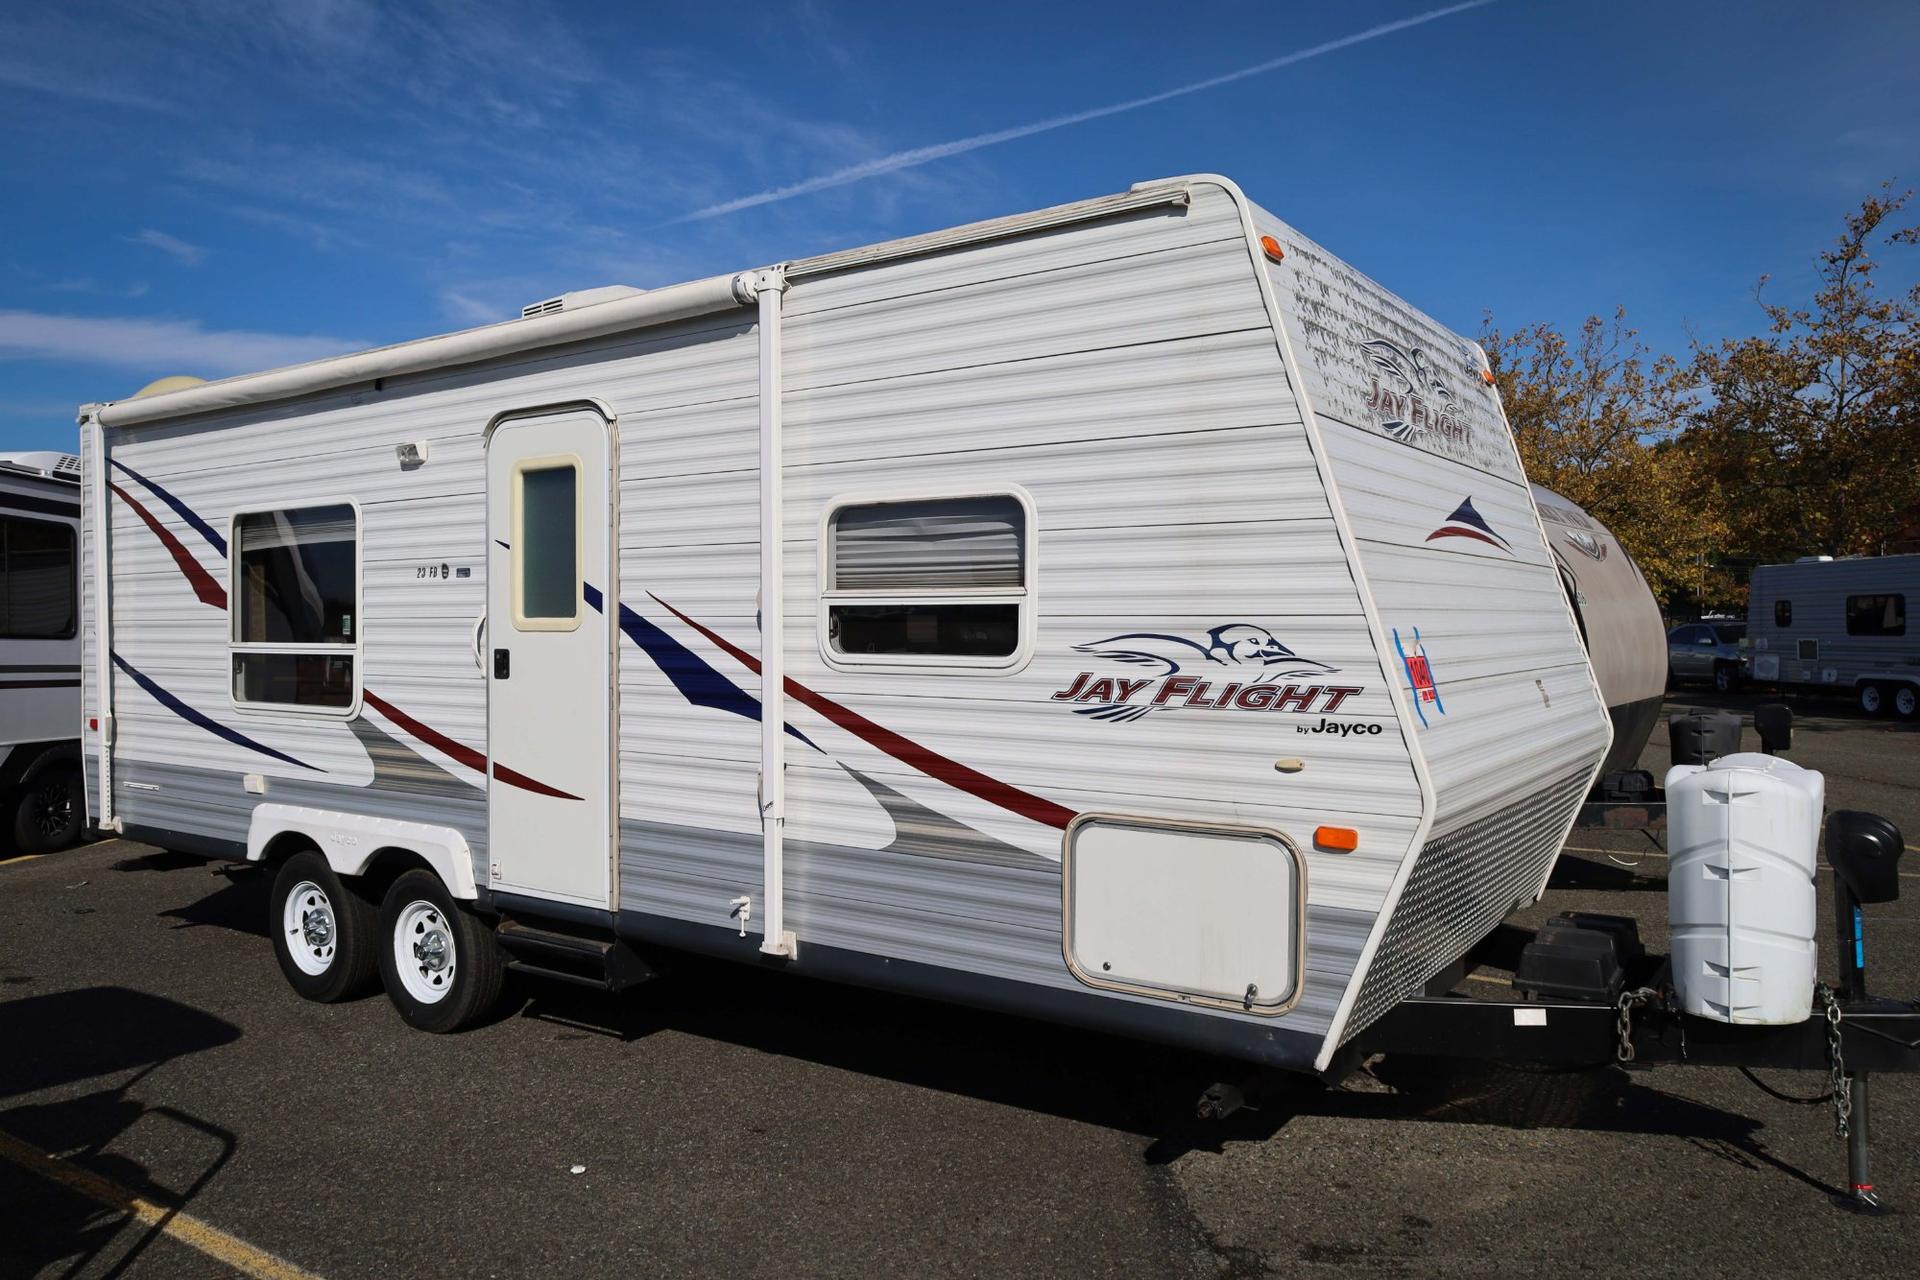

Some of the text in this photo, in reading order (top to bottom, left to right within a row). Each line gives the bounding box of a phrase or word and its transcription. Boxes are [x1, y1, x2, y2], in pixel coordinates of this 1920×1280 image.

[1366, 377, 1473, 446] JAY FLIGHT
[416, 567, 426, 579] 23
[429, 566, 438, 578] FB
[1050, 672, 1366, 714] JAY FLIGHT
[1296, 719, 1383, 738] by Jayco
